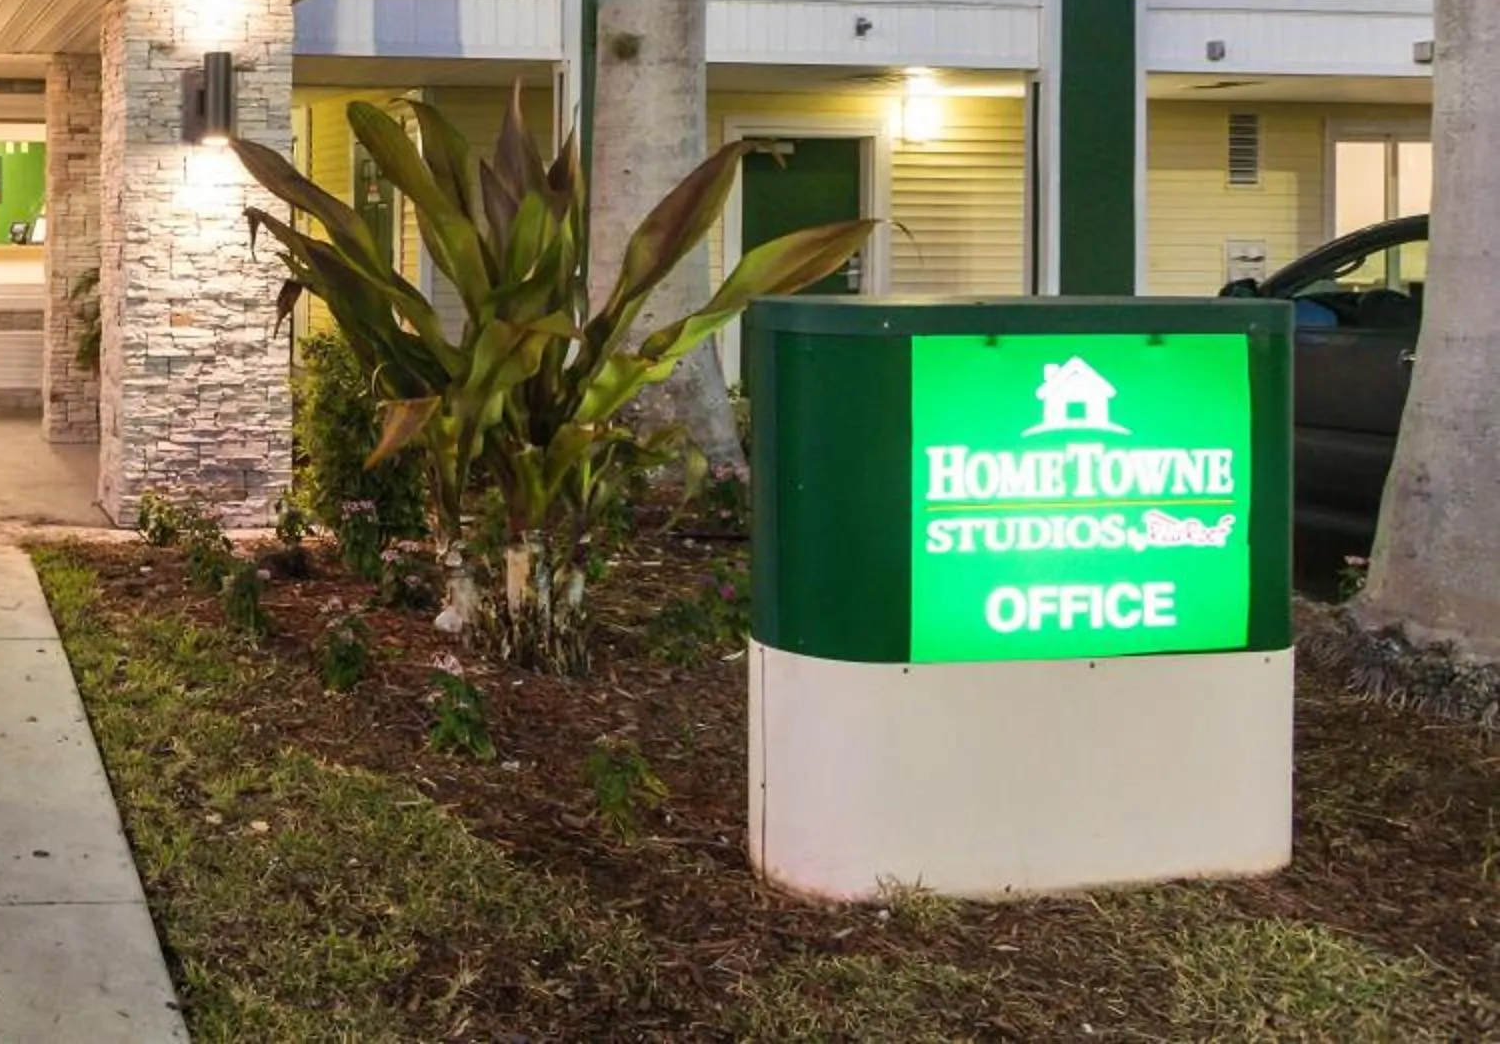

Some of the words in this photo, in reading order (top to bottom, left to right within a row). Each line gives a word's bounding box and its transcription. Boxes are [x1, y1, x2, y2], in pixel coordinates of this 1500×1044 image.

[926, 442, 1234, 500] HOMETOWNE
[926, 512, 1126, 553] STUDIOS
[985, 581, 1176, 633] OFFICE
